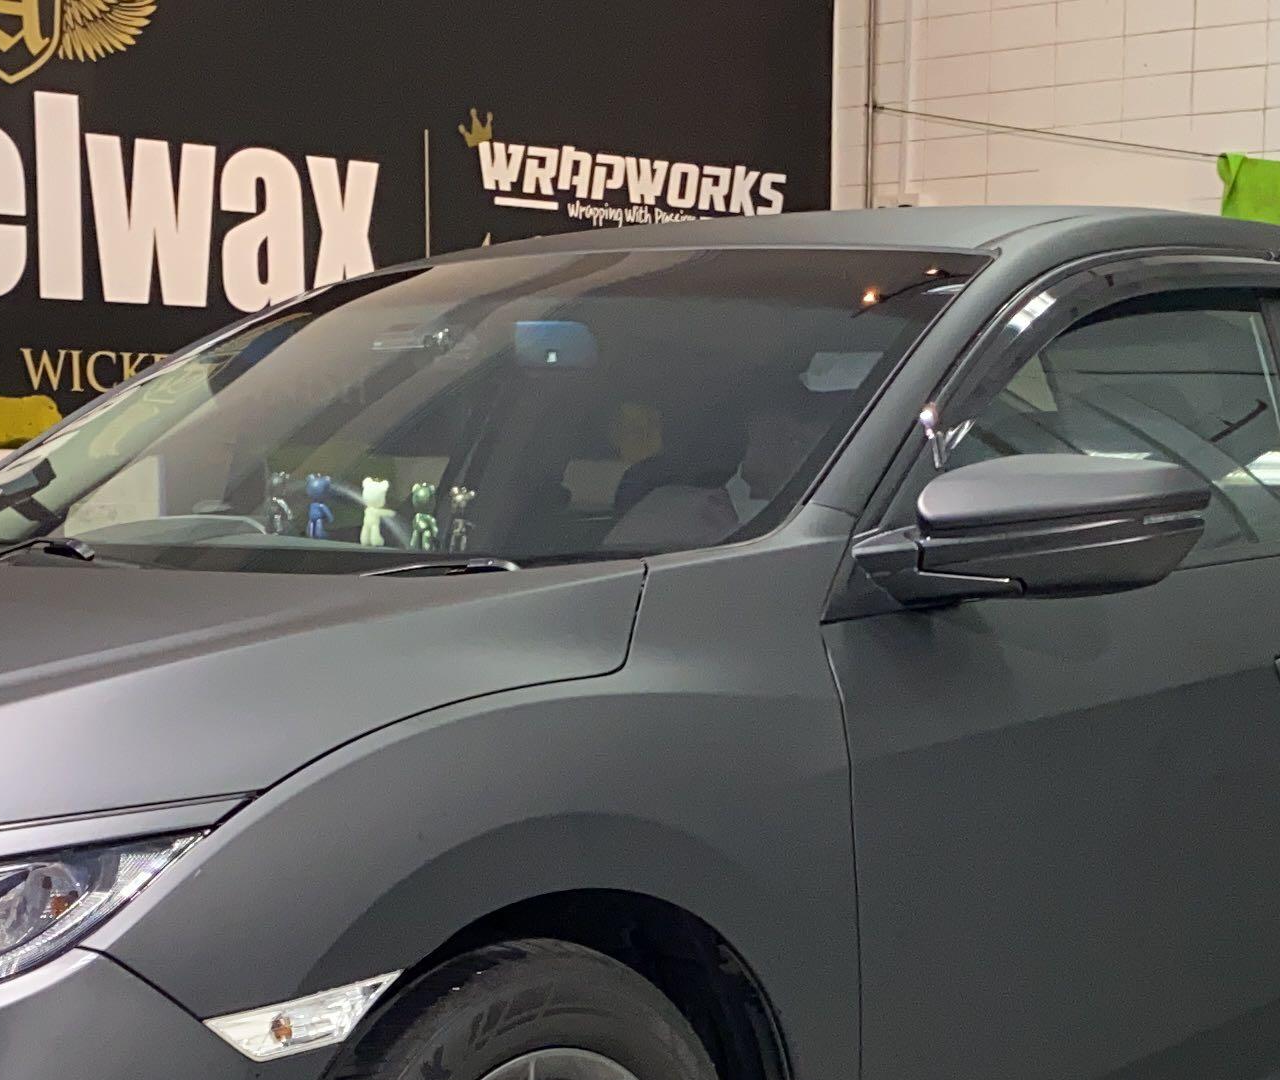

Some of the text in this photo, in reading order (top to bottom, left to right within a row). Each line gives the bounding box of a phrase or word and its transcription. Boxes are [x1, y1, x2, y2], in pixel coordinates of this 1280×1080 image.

[478, 141, 788, 217] WRAPWORKS
[567, 200, 623, 228] Wrapping
[19, 347, 169, 394] WICK
